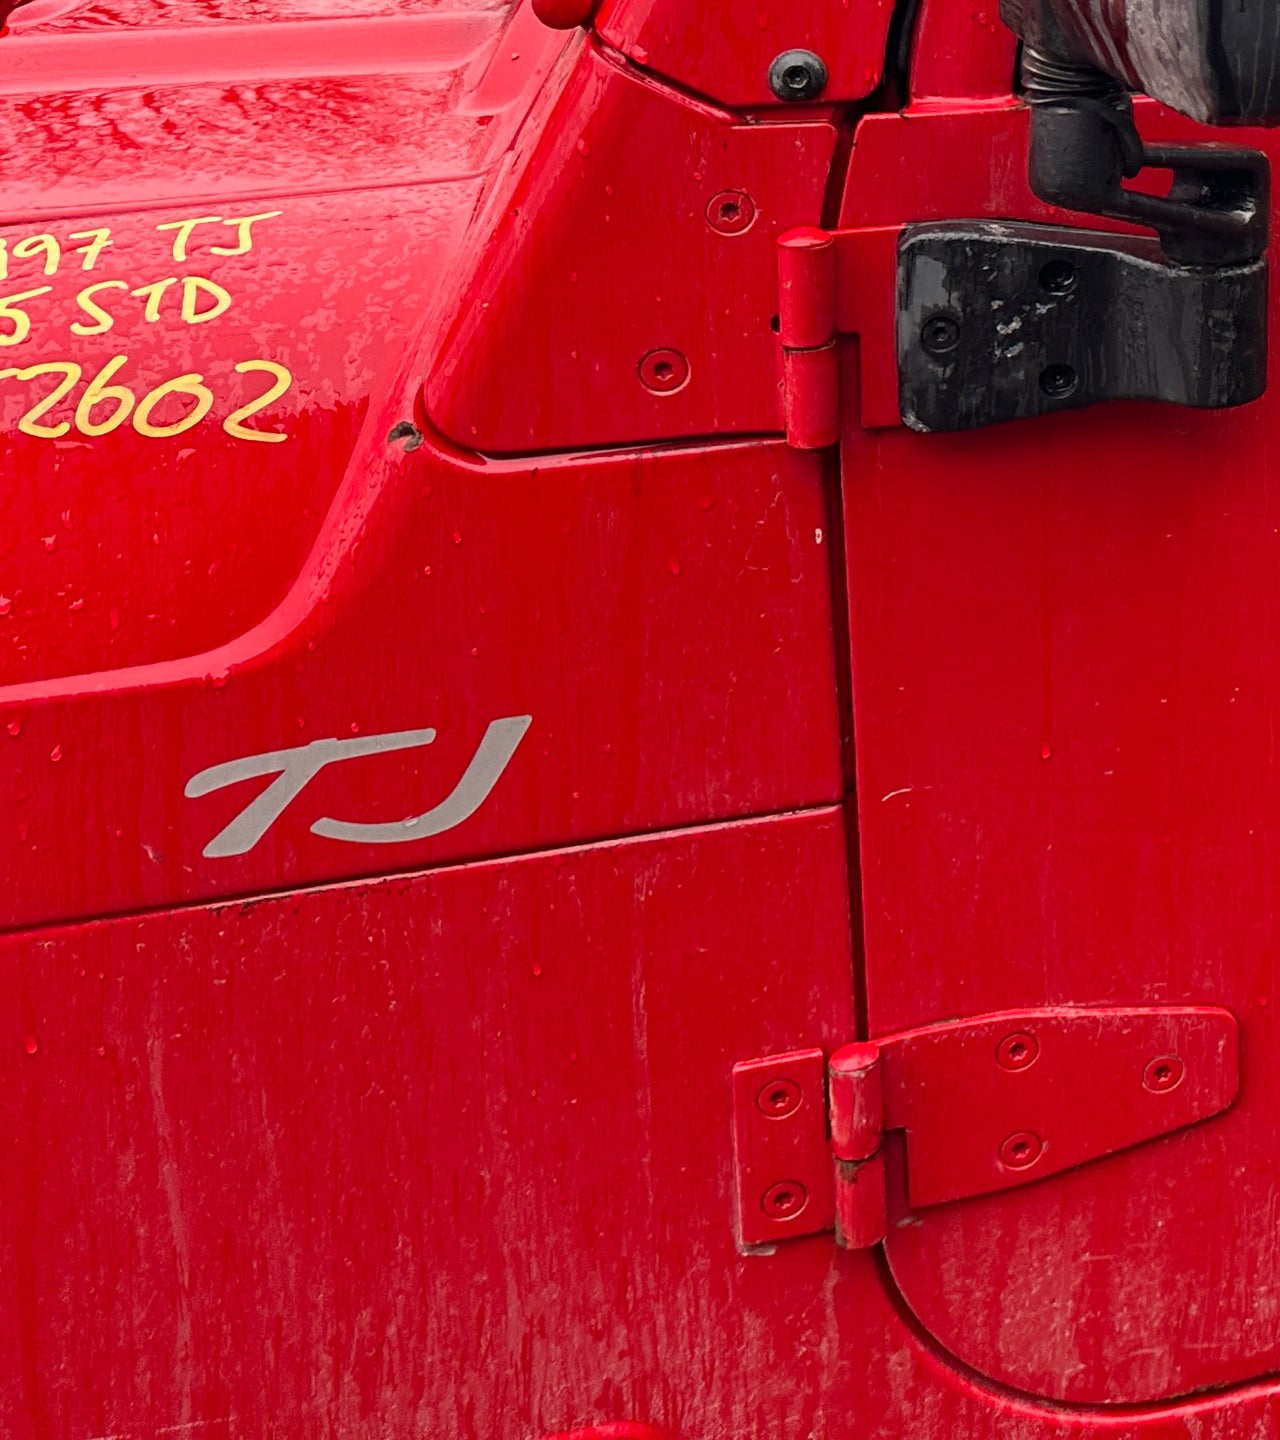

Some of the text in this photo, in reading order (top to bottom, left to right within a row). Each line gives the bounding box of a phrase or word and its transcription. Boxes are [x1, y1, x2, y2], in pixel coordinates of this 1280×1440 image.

[0, 210, 283, 280] 97 TJ
[70, 275, 232, 336] STD
[0, 354, 293, 443] 2602
[184, 713, 533, 859] TJ
